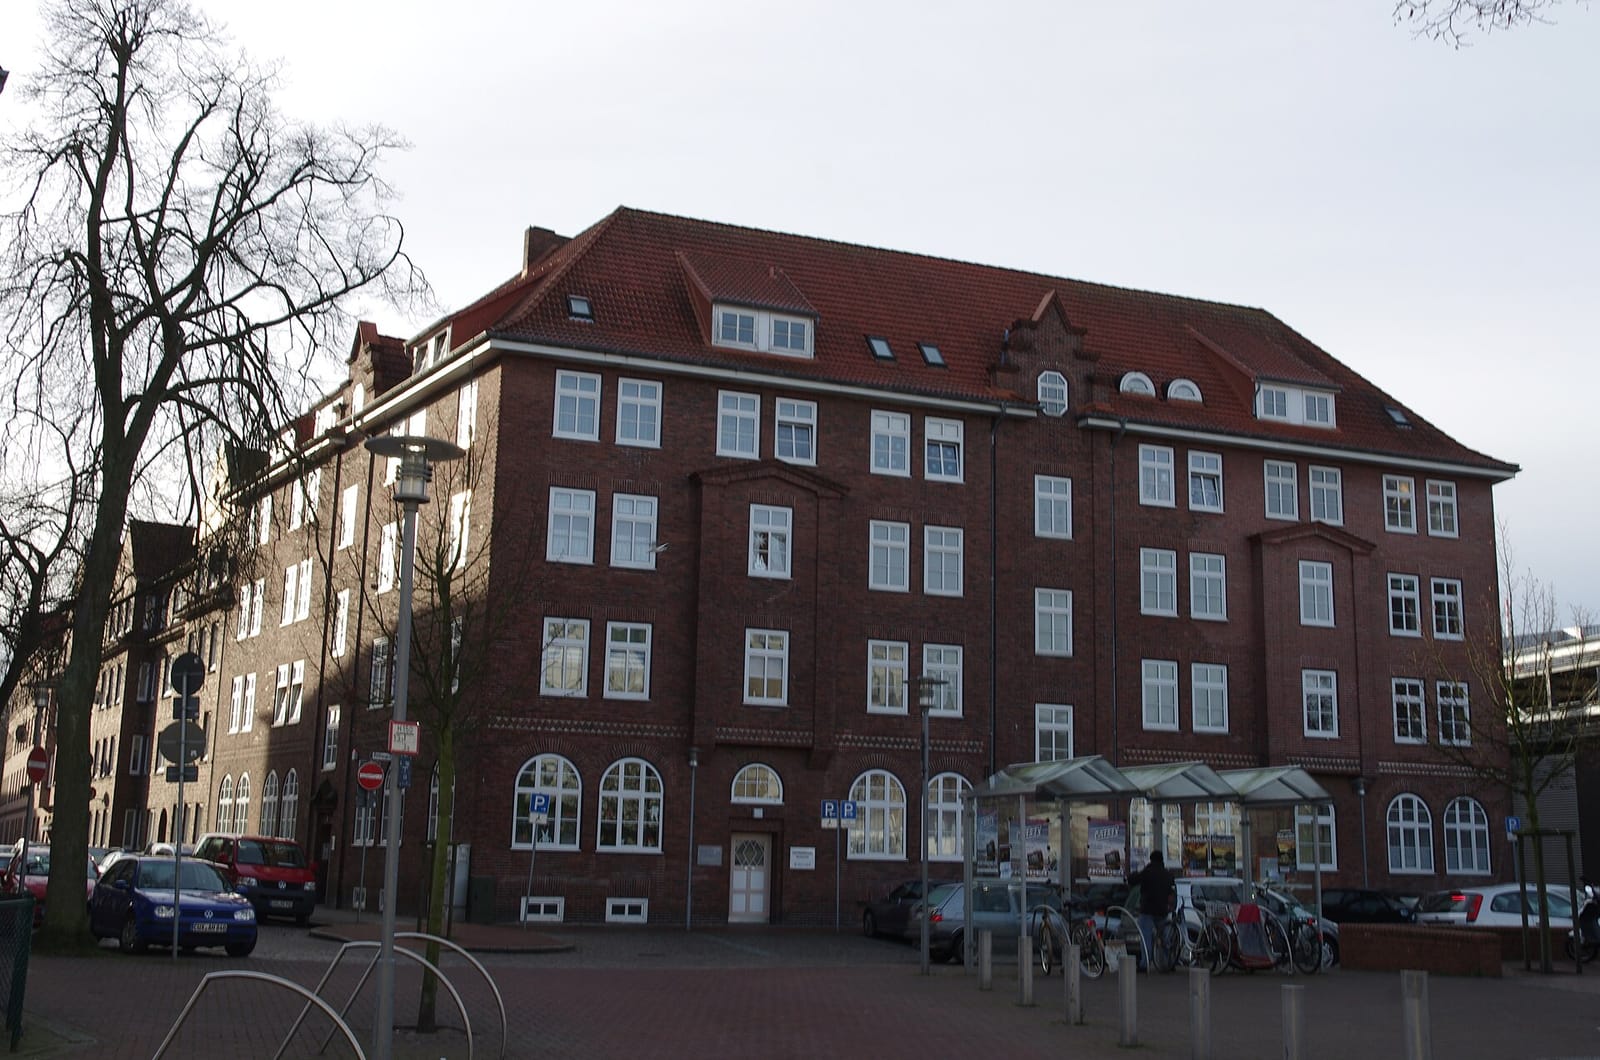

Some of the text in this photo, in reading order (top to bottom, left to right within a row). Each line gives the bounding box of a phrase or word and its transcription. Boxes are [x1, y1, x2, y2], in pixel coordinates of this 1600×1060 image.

[534, 795, 545, 811] P
[825, 802, 834, 817] P
[844, 802, 853, 817] P
[1508, 818, 1517, 831] P
